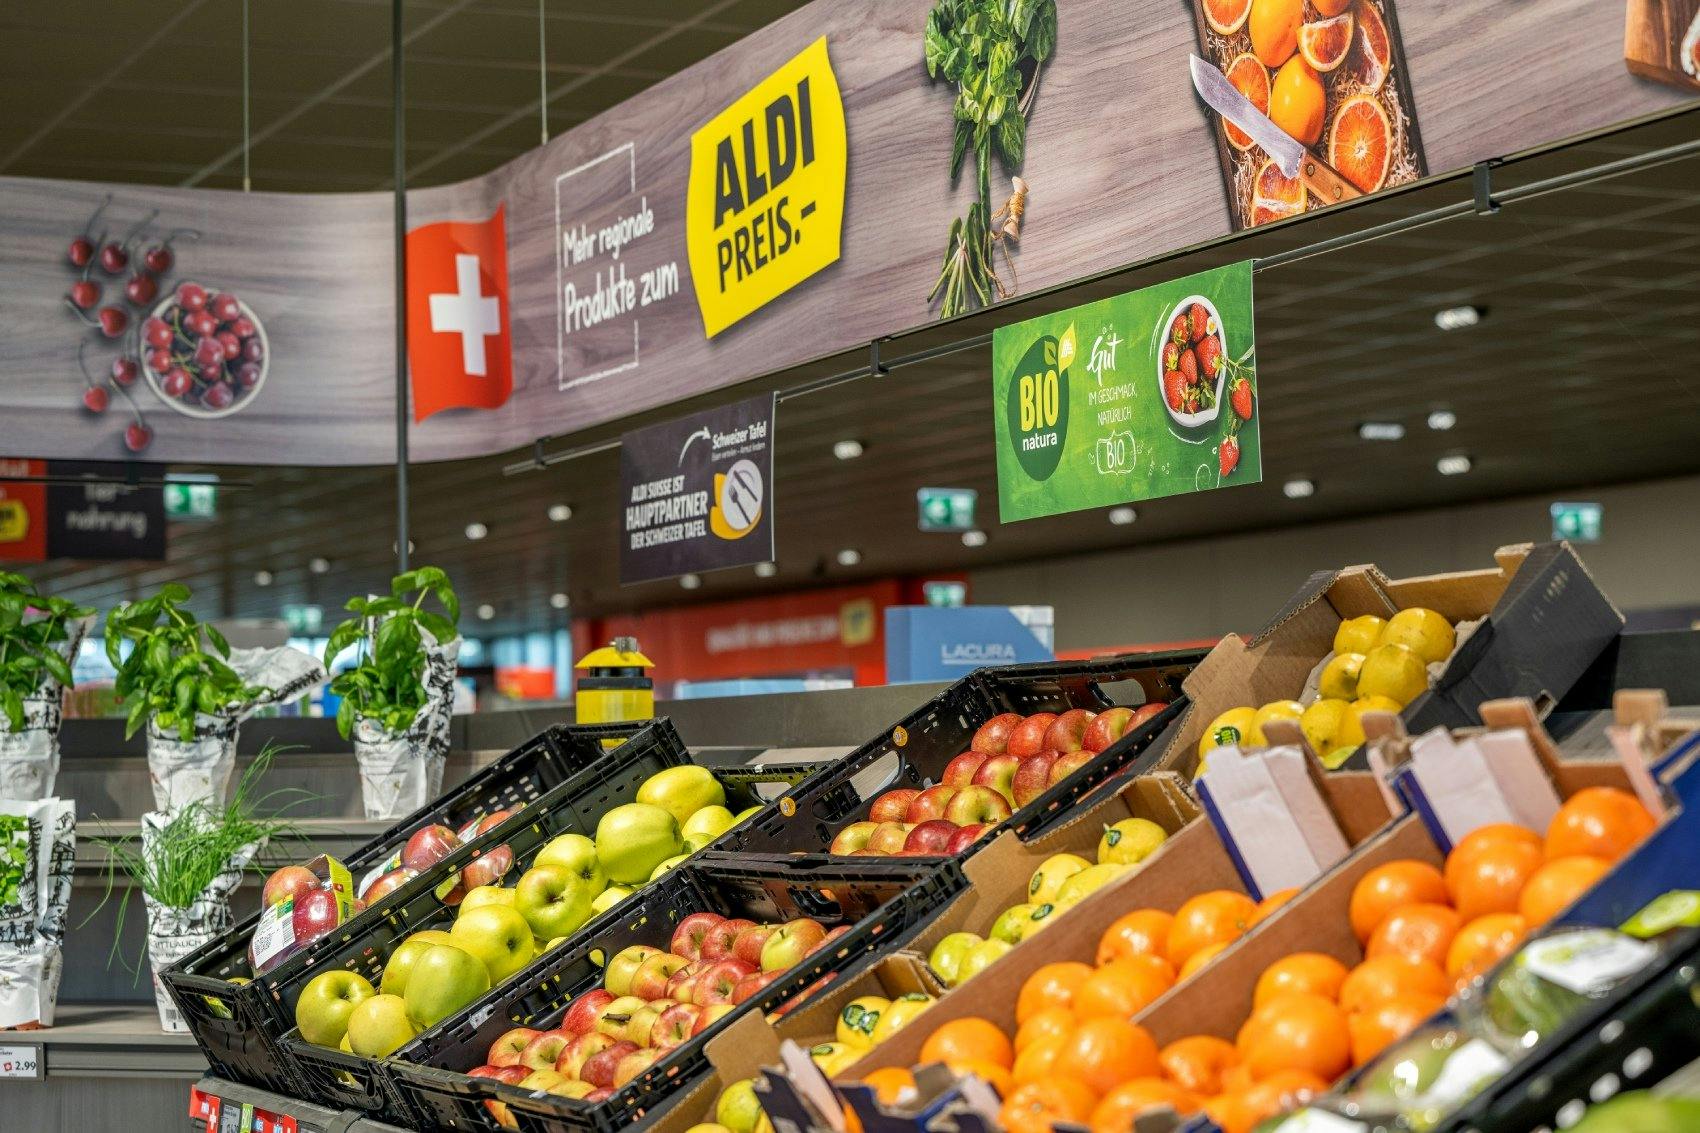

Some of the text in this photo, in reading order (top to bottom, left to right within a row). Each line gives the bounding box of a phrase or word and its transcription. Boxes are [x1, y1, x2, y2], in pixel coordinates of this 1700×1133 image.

[714, 75, 815, 230] ALDI
[563, 196, 655, 268] Mehr regionale
[717, 196, 816, 294] PREIS.-
[565, 262, 679, 334] Produkte zum
[1087, 333, 1124, 386] Gut
[1019, 369, 1059, 432] BIO
[1088, 392, 1098, 406] IM
[1098, 406, 1132, 426] NATÜRLICH
[712, 421, 767, 450] Schweizer Tafel
[1022, 432, 1058, 451] natura
[1106, 439, 1125, 469] BIO
[648, 477, 672, 499] SUISSE
[672, 475, 685, 493] IST
[626, 490, 708, 531] HAUPTPARTNER
[631, 519, 707, 550] DER SCHWEIZER TAFEL
[941, 643, 1017, 659] LACURA
[15, 1061, 36, 1071] 2.99
